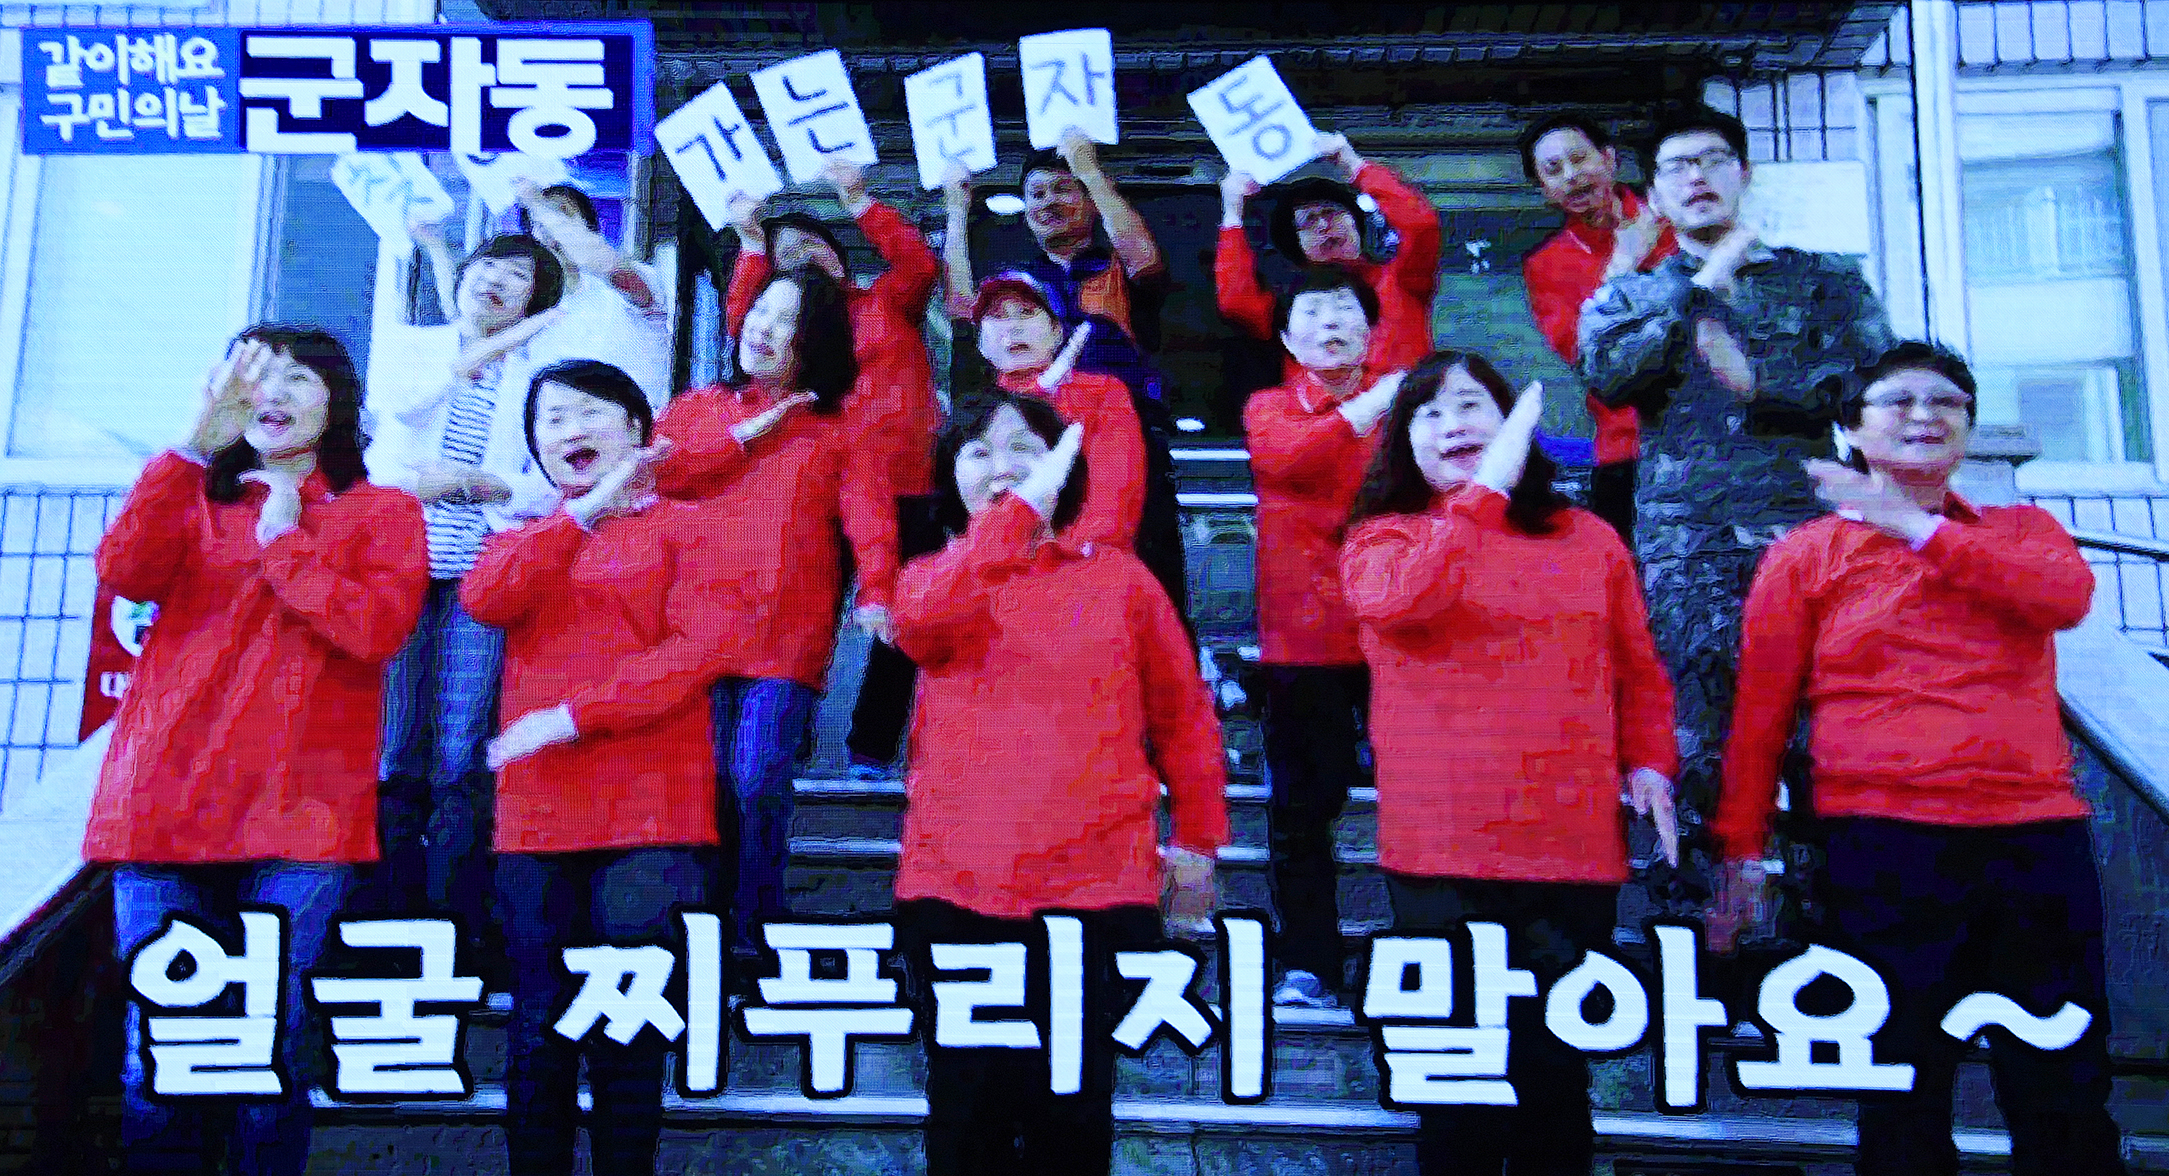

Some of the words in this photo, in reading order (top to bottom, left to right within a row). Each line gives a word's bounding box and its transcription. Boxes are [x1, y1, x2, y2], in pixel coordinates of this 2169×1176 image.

[37, 32, 226, 88] 같이해요
[238, 36, 614, 159] 군자동
[1029, 50, 1107, 116] 자
[39, 86, 228, 142] 구민의날
[674, 115, 744, 183] 가
[781, 74, 850, 154] 는
[925, 70, 977, 162] 군
[1217, 73, 1294, 163] 동
[129, 910, 484, 1097] 얼굴
[554, 911, 1265, 1098] 찌푸리지
[1361, 919, 2094, 1108] 말아요~
